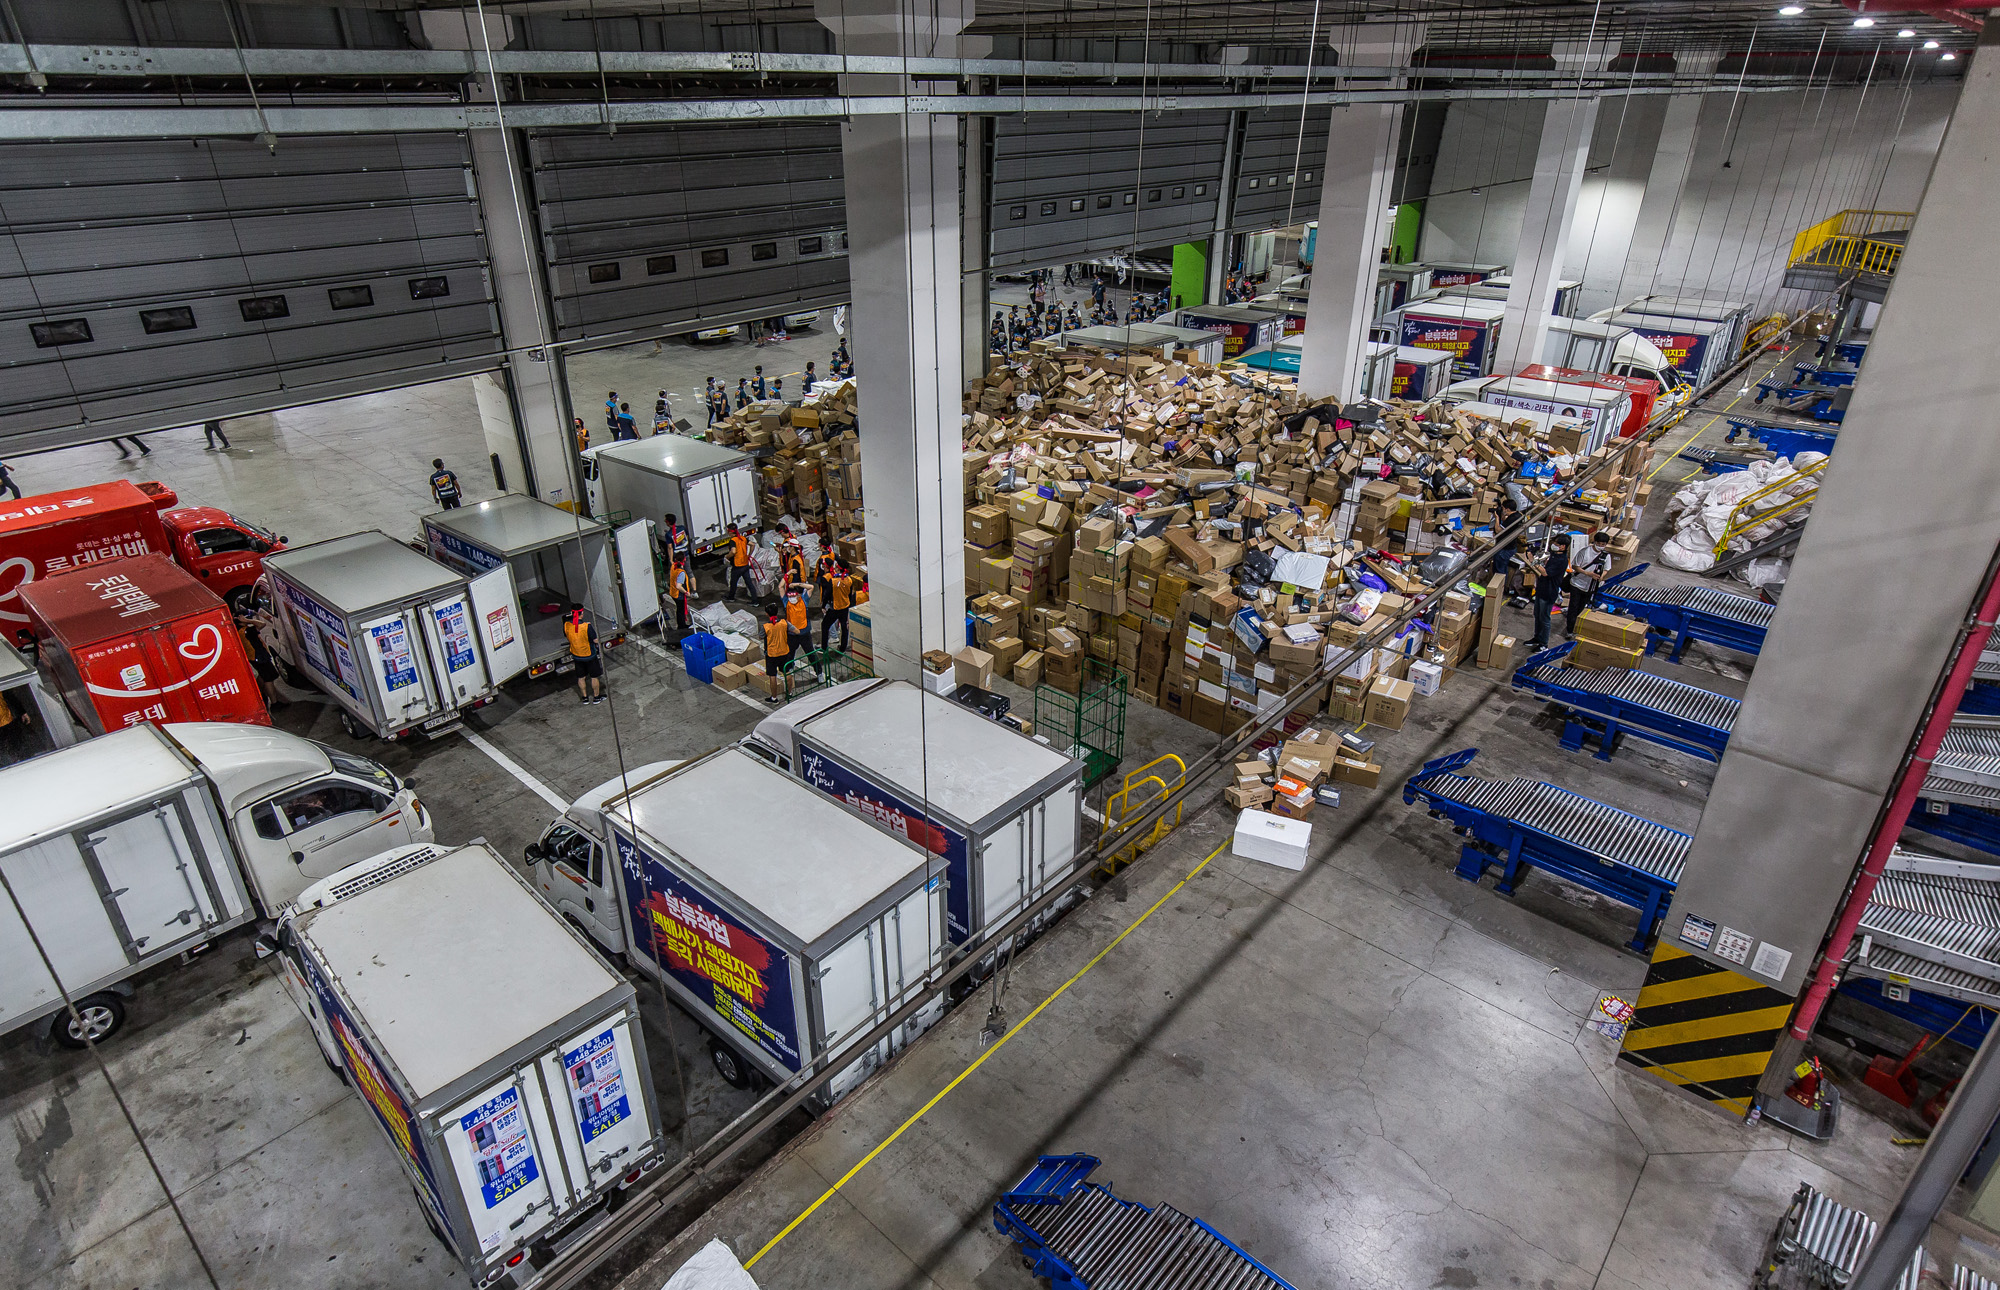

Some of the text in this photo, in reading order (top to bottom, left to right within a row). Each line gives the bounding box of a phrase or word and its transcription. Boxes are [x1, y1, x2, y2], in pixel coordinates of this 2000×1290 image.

[217, 560, 255, 576] LOTTE
[453, 660, 471, 671] SALE
[198, 678, 240, 701] 택배
[392, 678, 413, 690] SALE
[664, 888, 731, 949] 분류작업
[651, 908, 763, 989] 택배사가 책임지고
[666, 934, 694, 967] 즉각
[697, 953, 754, 1004] 시행하라!
[566, 1036, 612, 1066] T.448-5001
[464, 1095, 515, 1128] T.448-5001
[591, 1113, 622, 1138] SALE
[494, 1175, 529, 1202] SALE
